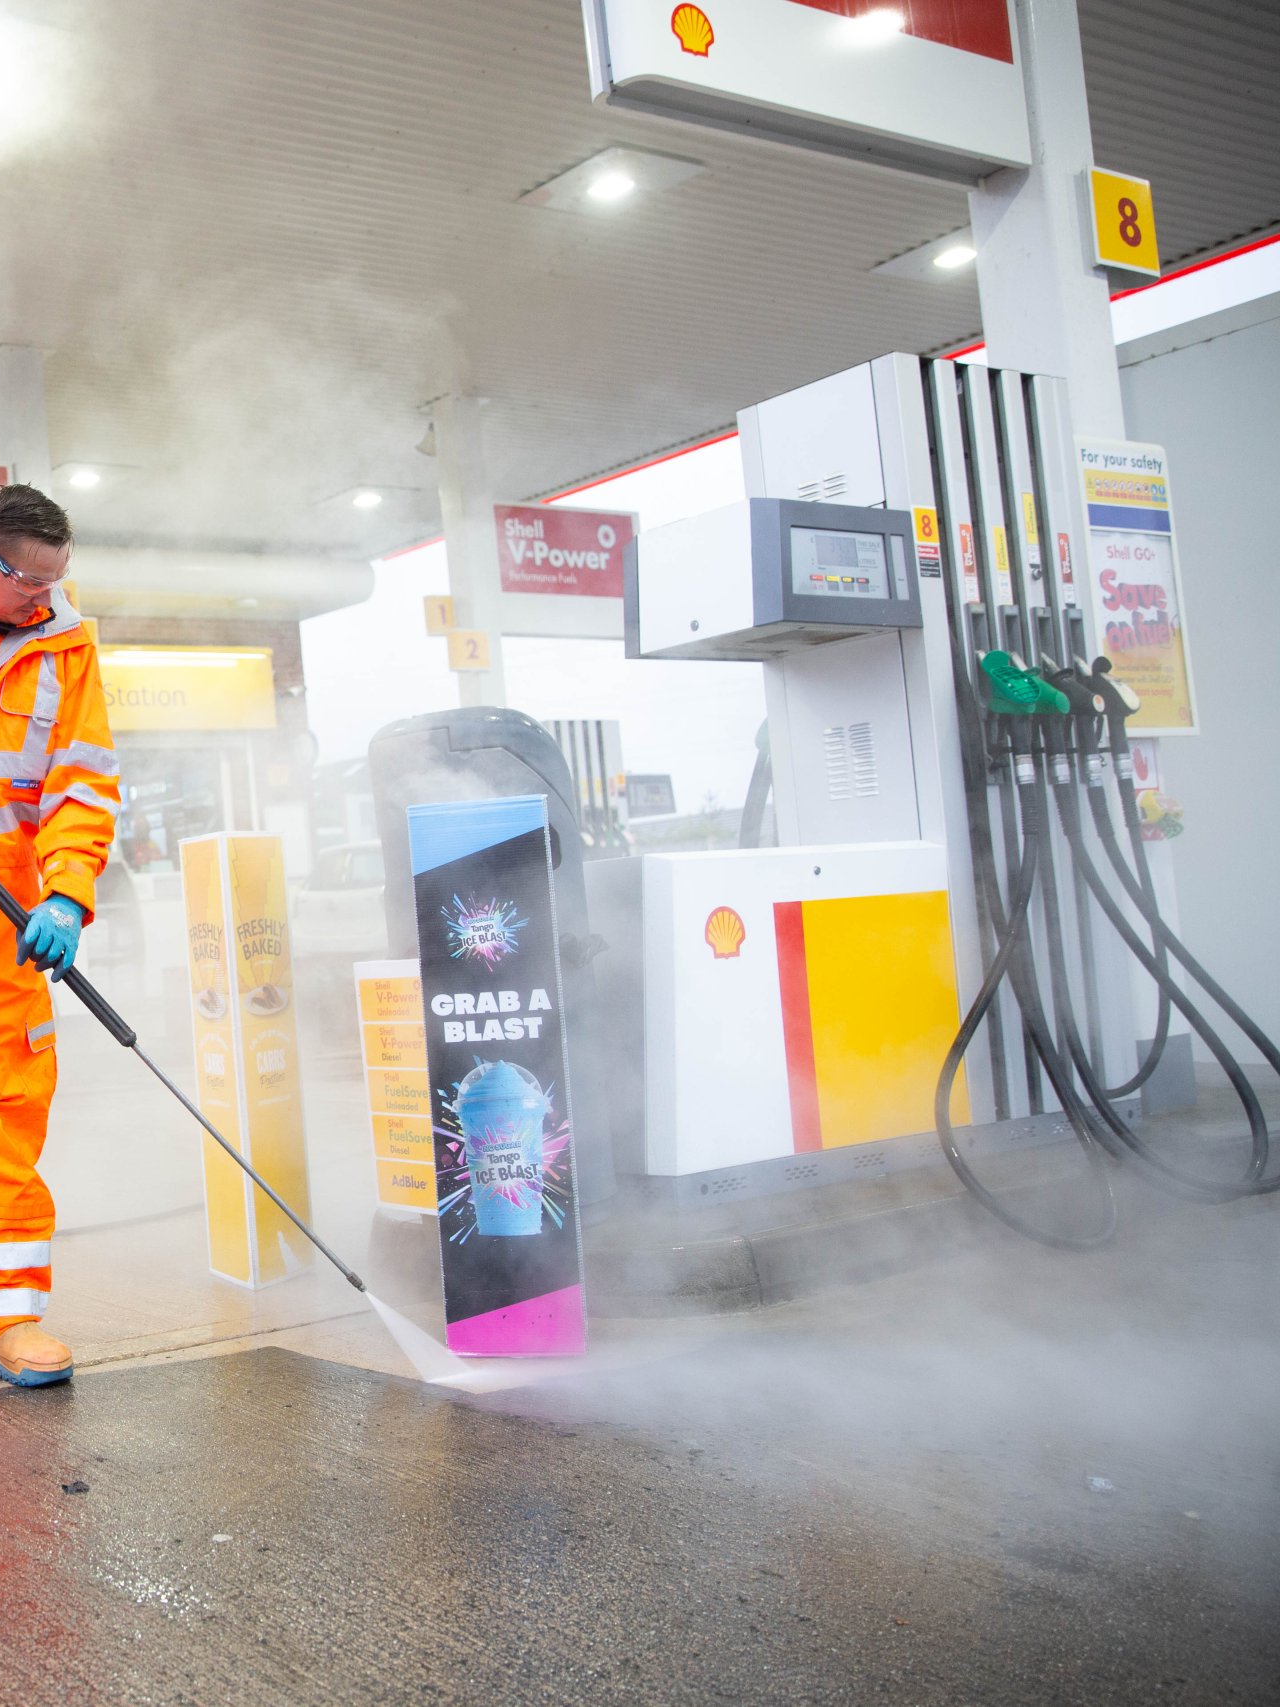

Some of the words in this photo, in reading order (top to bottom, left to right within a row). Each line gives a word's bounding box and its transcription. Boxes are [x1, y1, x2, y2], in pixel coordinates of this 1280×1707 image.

[1118, 197, 1141, 247] 8
[1081, 448, 1099, 464] For
[1103, 454, 1127, 468] your
[1131, 455, 1162, 474] safety
[505, 518, 544, 538] Shell
[921, 515, 933, 537] 8
[506, 540, 609, 570] V-Power
[1106, 544, 1130, 560] Shell
[1100, 568, 1167, 611] Save
[437, 604, 447, 625] 1
[1105, 621, 1136, 653] on
[1131, 610, 1171, 646] fuel
[466, 639, 479, 659] 2
[103, 683, 186, 706] Station
[189, 923, 222, 943] FRESHLY
[237, 918, 285, 943] FRESHLY
[471, 924, 494, 933] Tango
[463, 934, 477, 947] ICE
[478, 931, 507, 944] BLAST
[193, 944, 220, 962] BAKED
[242, 938, 282, 960] BAKED
[375, 981, 390, 990] Shell
[376, 991, 418, 1003] V-Power
[431, 990, 520, 1016] GRAB
[528, 988, 552, 1011] A
[377, 1008, 409, 1016] Unleaded
[379, 1027, 395, 1036] Shell
[444, 1017, 542, 1043] BLAST
[380, 1038, 423, 1050] V-Power
[255, 1049, 287, 1073] CARRS
[381, 1053, 401, 1062] Diesel
[384, 1073, 400, 1082] Shell
[385, 1085, 428, 1099] FuelSave
[386, 1102, 419, 1112] Unleaded
[388, 1120, 403, 1129] Shell
[389, 1130, 432, 1144] FuelSave
[390, 1145, 410, 1155] Diesel
[487, 1152, 520, 1165] Tango
[392, 1174, 427, 1190] AdBlue
[475, 1168, 496, 1184] ICE
[498, 1163, 539, 1181] BLAST
